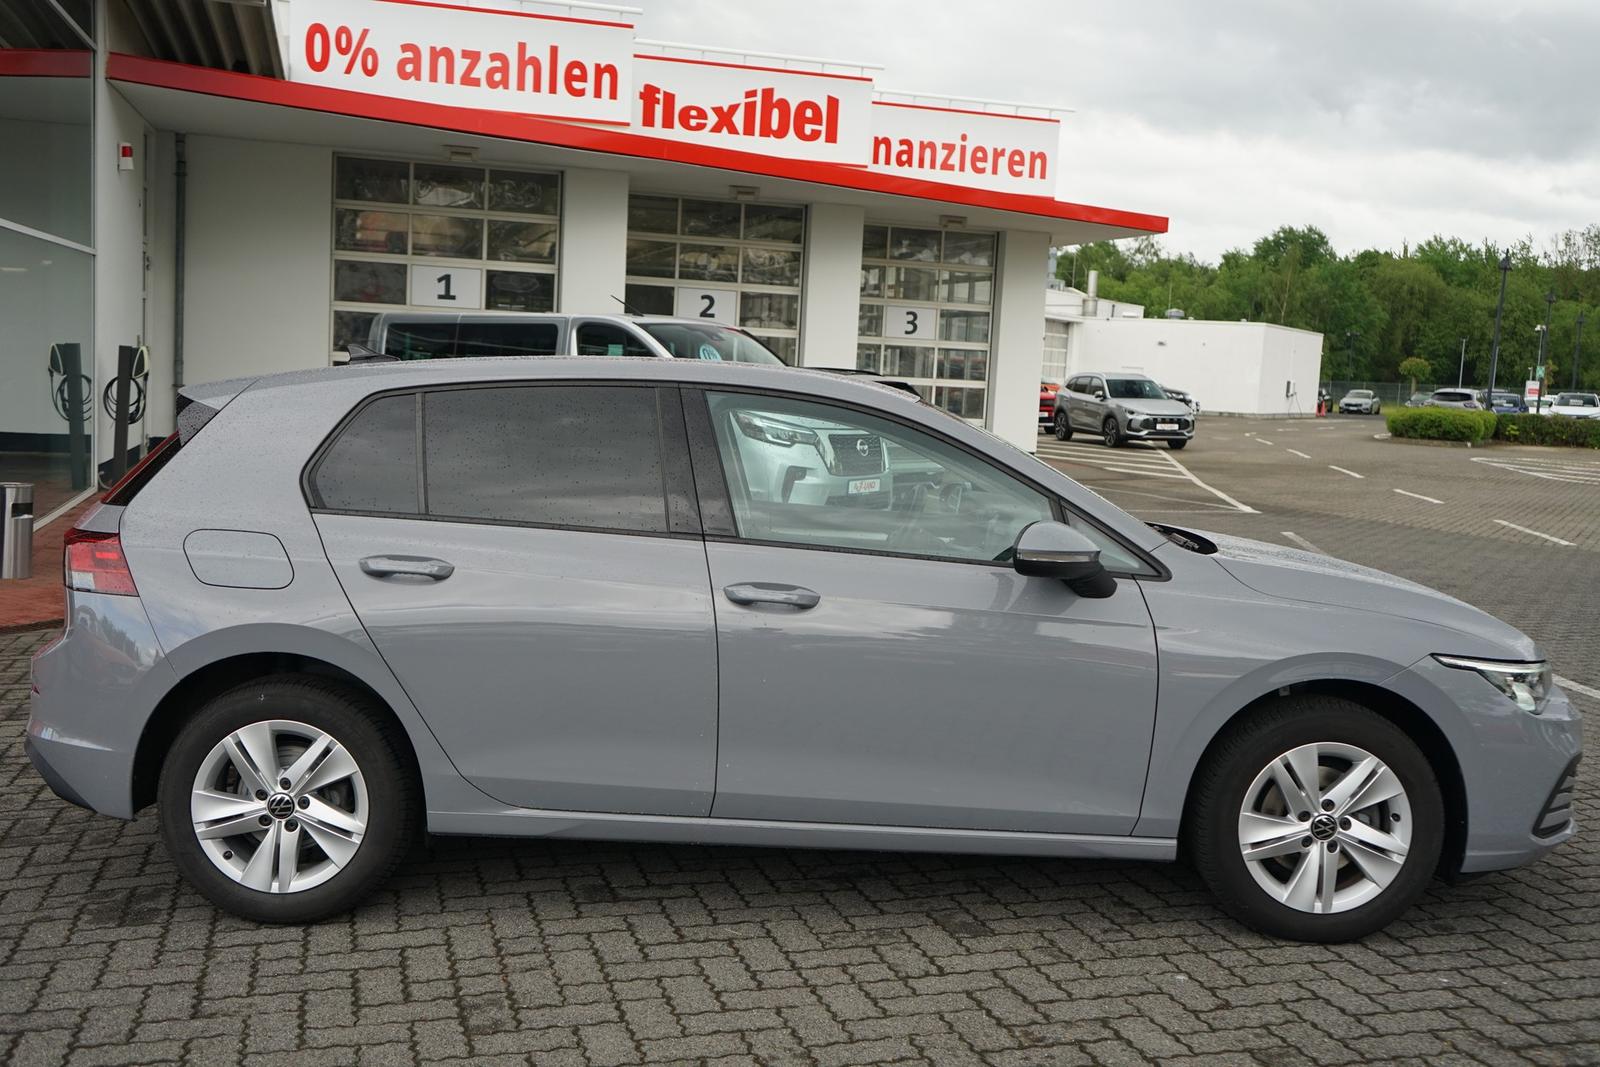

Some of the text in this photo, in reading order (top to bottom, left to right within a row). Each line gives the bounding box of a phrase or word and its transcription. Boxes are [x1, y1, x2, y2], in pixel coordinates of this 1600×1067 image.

[305, 22, 619, 101] 0% anzahlen
[639, 83, 840, 145] flexibel
[873, 133, 1048, 180] nanzieren
[436, 273, 457, 301] 1
[699, 294, 716, 319] 2
[904, 310, 919, 335] 3
